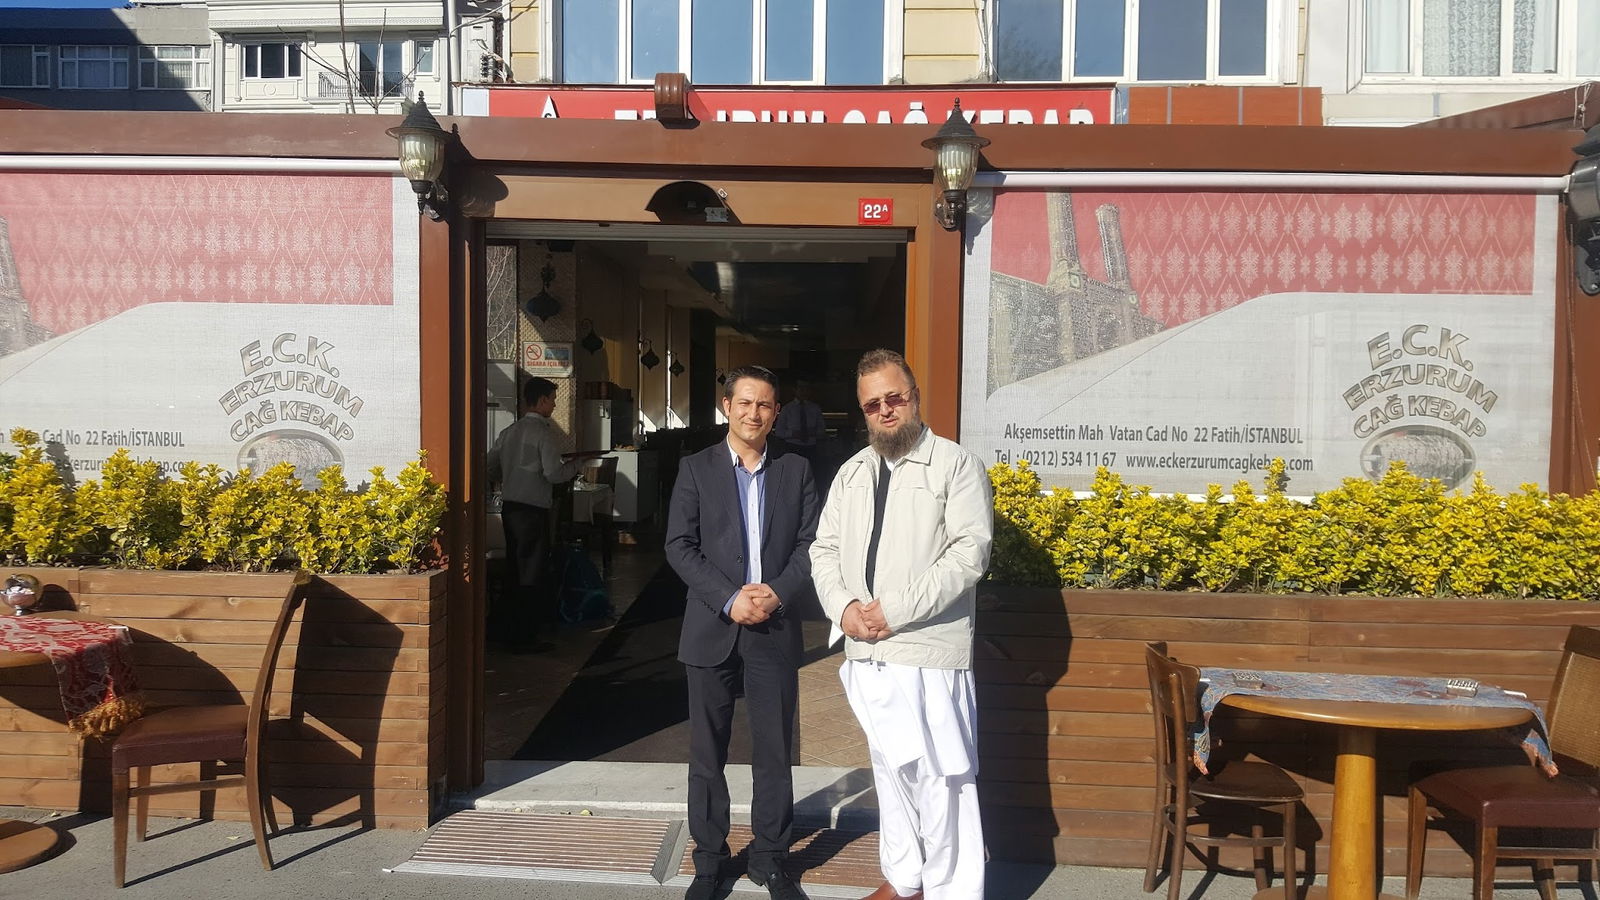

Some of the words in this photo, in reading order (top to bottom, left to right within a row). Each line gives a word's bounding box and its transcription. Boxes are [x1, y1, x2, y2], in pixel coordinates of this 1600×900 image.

[864, 204, 888, 219] 22A
[240, 333, 340, 378] E.C.K.
[1367, 324, 1474, 371] E.C.K.
[219, 371, 365, 418] ERZURUM
[1342, 364, 1498, 414] ERZURUM
[43, 429, 63, 444] Cad
[66, 430, 81, 445] No
[86, 431, 99, 446] 22
[101, 428, 185, 447] Fatih/İSTANBUL
[230, 400, 277, 442] CAĞ
[280, 401, 354, 442] KEBAP
[1004, 423, 1076, 443] Akşemsettin
[1078, 424, 1104, 441] Mah
[1109, 425, 1143, 441] Vatan
[1146, 425, 1168, 442] Cad
[1171, 426, 1188, 442] No
[1193, 427, 1209, 442] 22
[1211, 424, 1304, 444] Fatih/İSTANBUL
[1353, 394, 1405, 439] CAĞ
[1408, 395, 1487, 438] KEBAP
[995, 449, 1011, 464] Tel
[1022, 449, 1058, 468] (0212)
[1061, 451, 1082, 467] 534
[1102, 452, 1117, 467] 67
[1126, 452, 1313, 474] www.eckerzurumcagkeb.com
